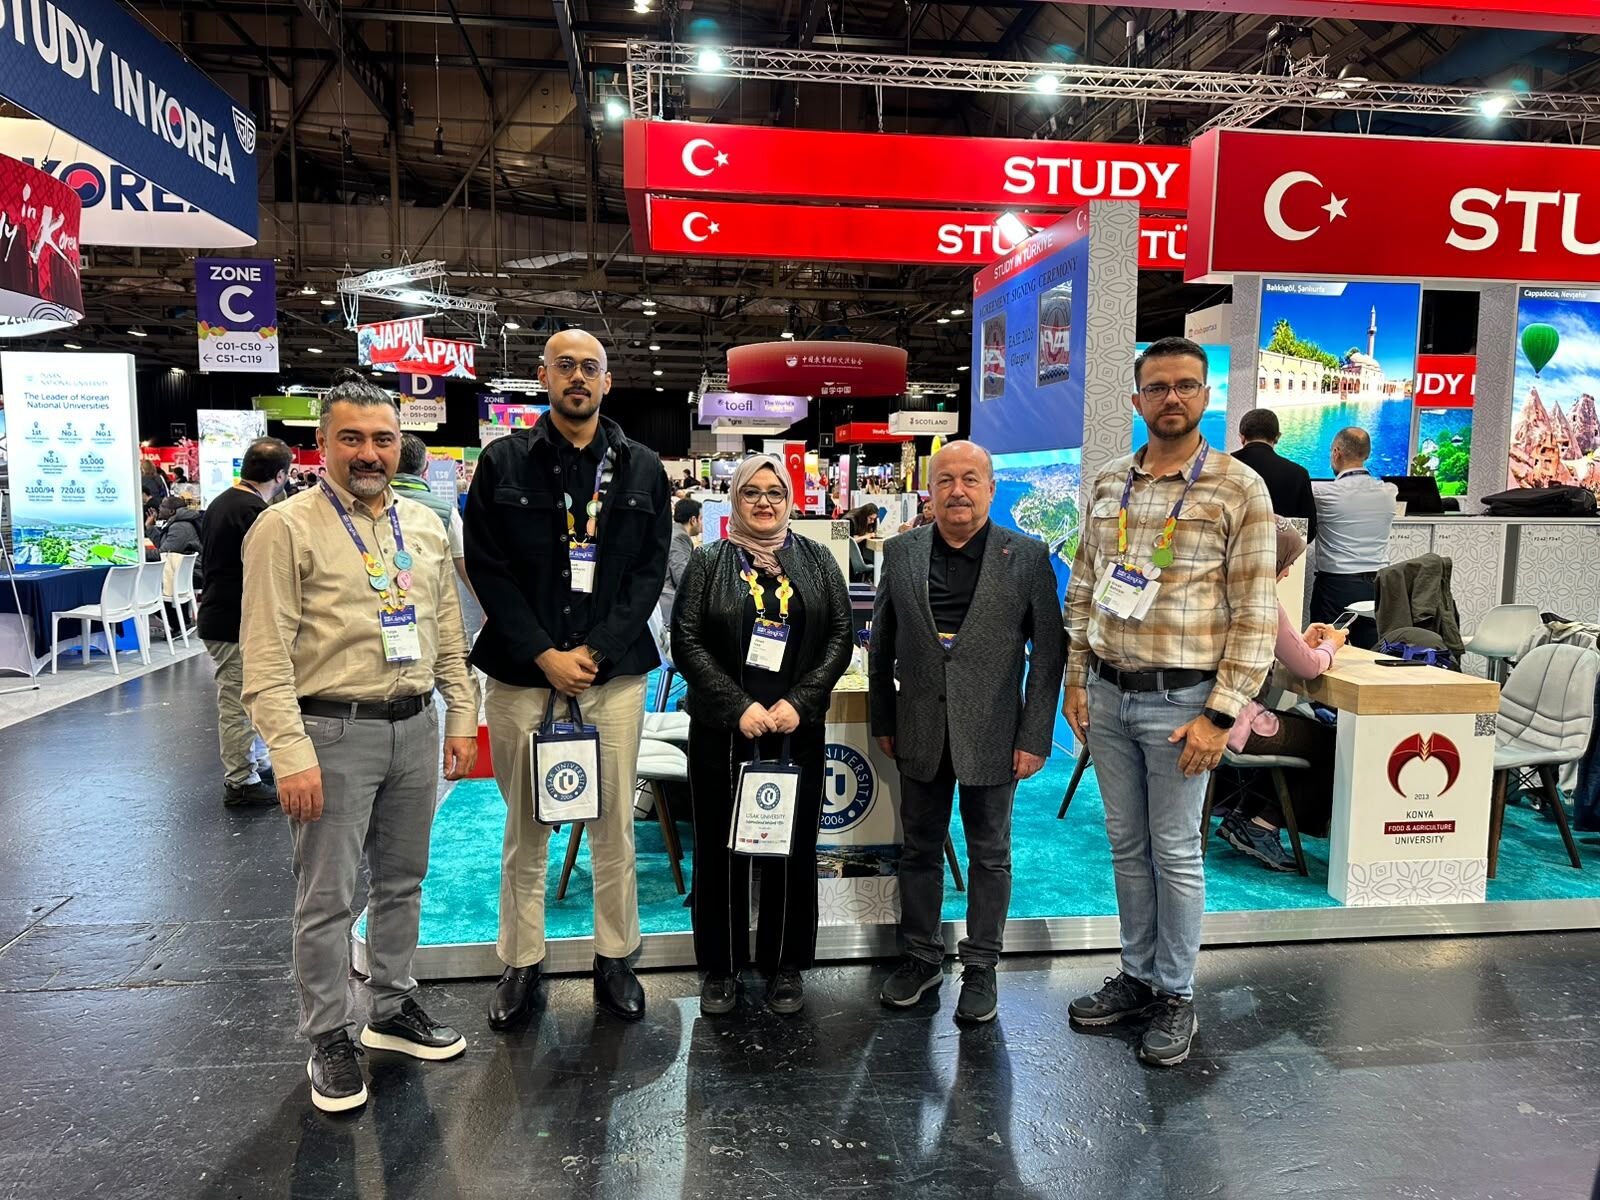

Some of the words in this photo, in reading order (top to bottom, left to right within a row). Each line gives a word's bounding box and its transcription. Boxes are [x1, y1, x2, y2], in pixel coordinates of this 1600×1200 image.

[0, 0, 104, 95] TUDY
[111, 51, 146, 126] IN
[149, 80, 235, 184] KOREA
[1004, 156, 1180, 199] STUDY
[1445, 188, 1600, 255] STU
[994, 257, 1015, 279] STUDY
[1014, 254, 1022, 268] IN
[209, 266, 261, 281] ZONE
[979, 291, 1010, 316] AGREEMENT
[1011, 278, 1036, 301] SIGNING
[1038, 256, 1078, 288] CEREMONY
[1524, 289, 1560, 299] Cappadocia,
[219, 284, 255, 322] C
[375, 319, 424, 351] JAPAN
[215, 342, 262, 352] C01-C50
[216, 354, 263, 364] C51-C119
[412, 373, 433, 395] D
[821, 386, 852, 395] 留学中国
[24, 392, 40, 401] The
[41, 393, 68, 401] Leader
[70, 393, 79, 401] of
[80, 393, 110, 402] Korean
[26, 401, 61, 409] National
[62, 402, 110, 410] Universities
[725, 400, 753, 412] toefl
[554, 763, 586, 791] UNIVERSITY
[1414, 793, 1430, 801] 2013
[1406, 810, 1434, 819] KONYA
[1412, 823, 1452, 832] AGRICULTURE
[1395, 835, 1445, 845] UNIVERSITY
